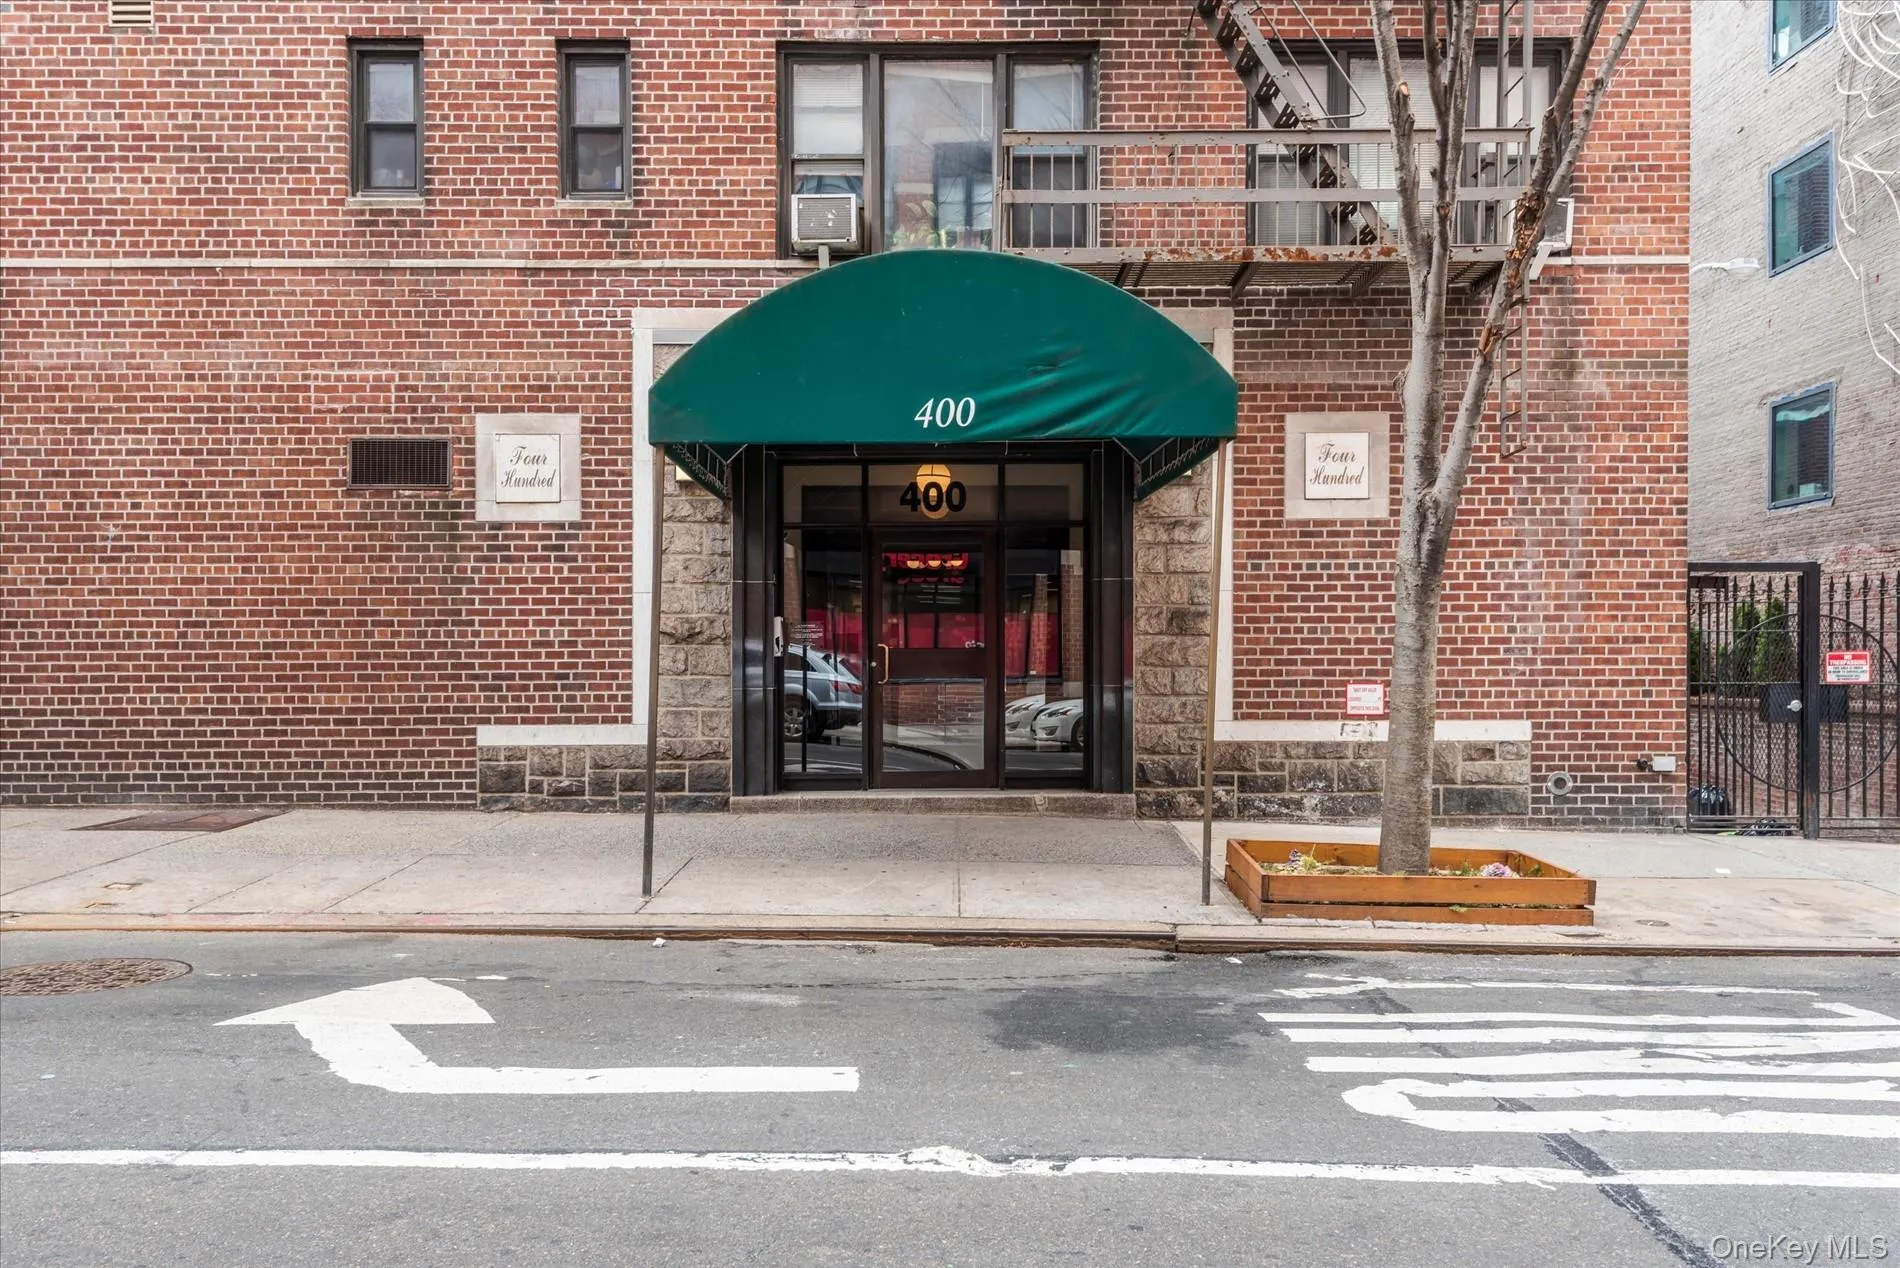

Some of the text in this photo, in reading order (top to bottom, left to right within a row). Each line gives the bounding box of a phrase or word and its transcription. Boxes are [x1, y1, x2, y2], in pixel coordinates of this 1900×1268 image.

[914, 397, 976, 428] 400
[510, 446, 548, 466] Four
[1318, 442, 1356, 463] Four
[501, 468, 557, 488] Hundred
[1310, 465, 1365, 485] Hundred
[900, 481, 967, 512] 400
